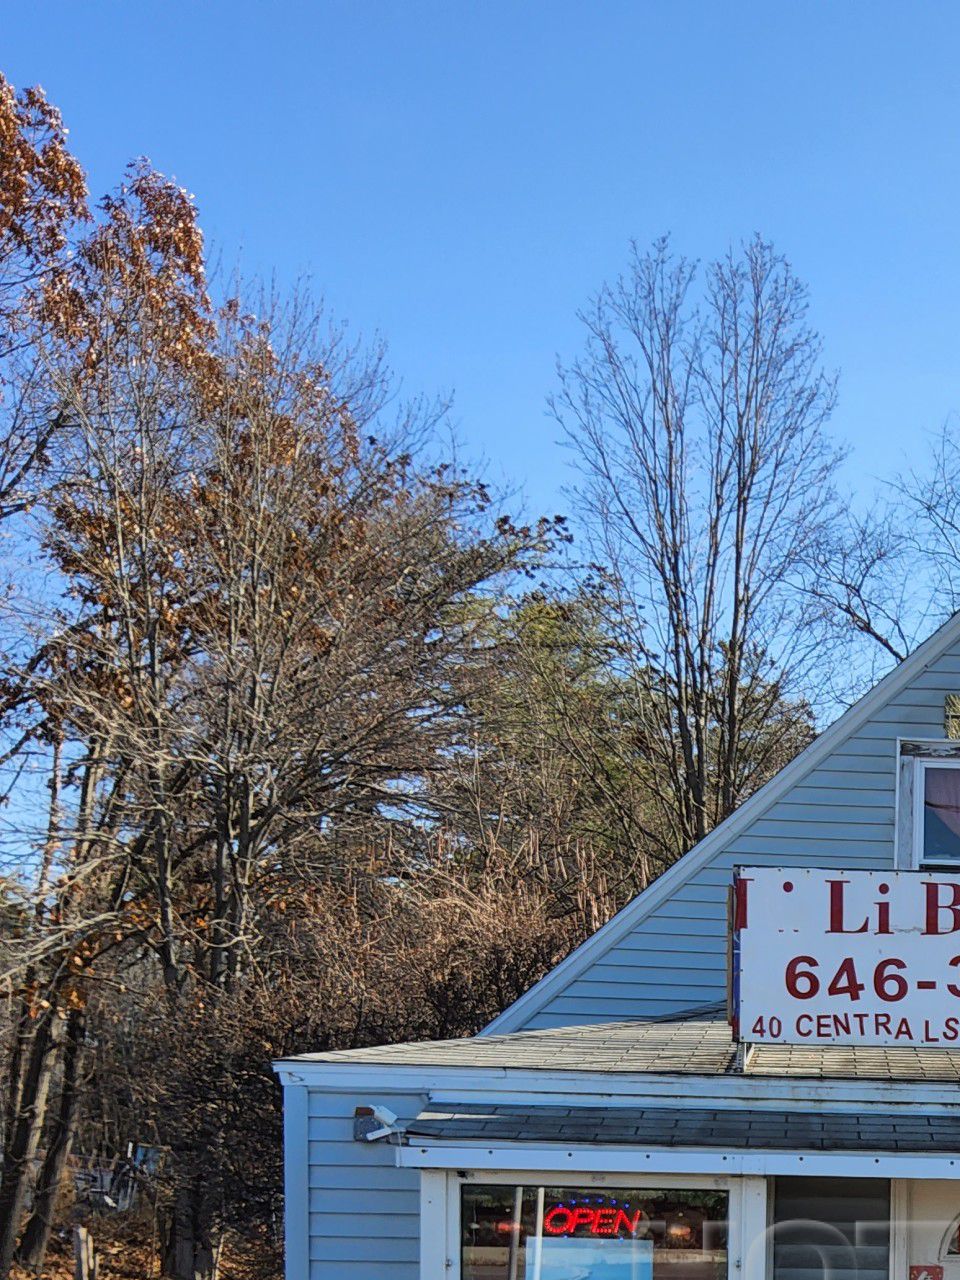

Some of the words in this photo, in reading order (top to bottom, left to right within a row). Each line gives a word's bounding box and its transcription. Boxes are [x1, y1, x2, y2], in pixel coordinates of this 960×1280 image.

[824, 879, 895, 935] Li
[752, 1015, 783, 1039] 40
[544, 1207, 641, 1234] OPEN
